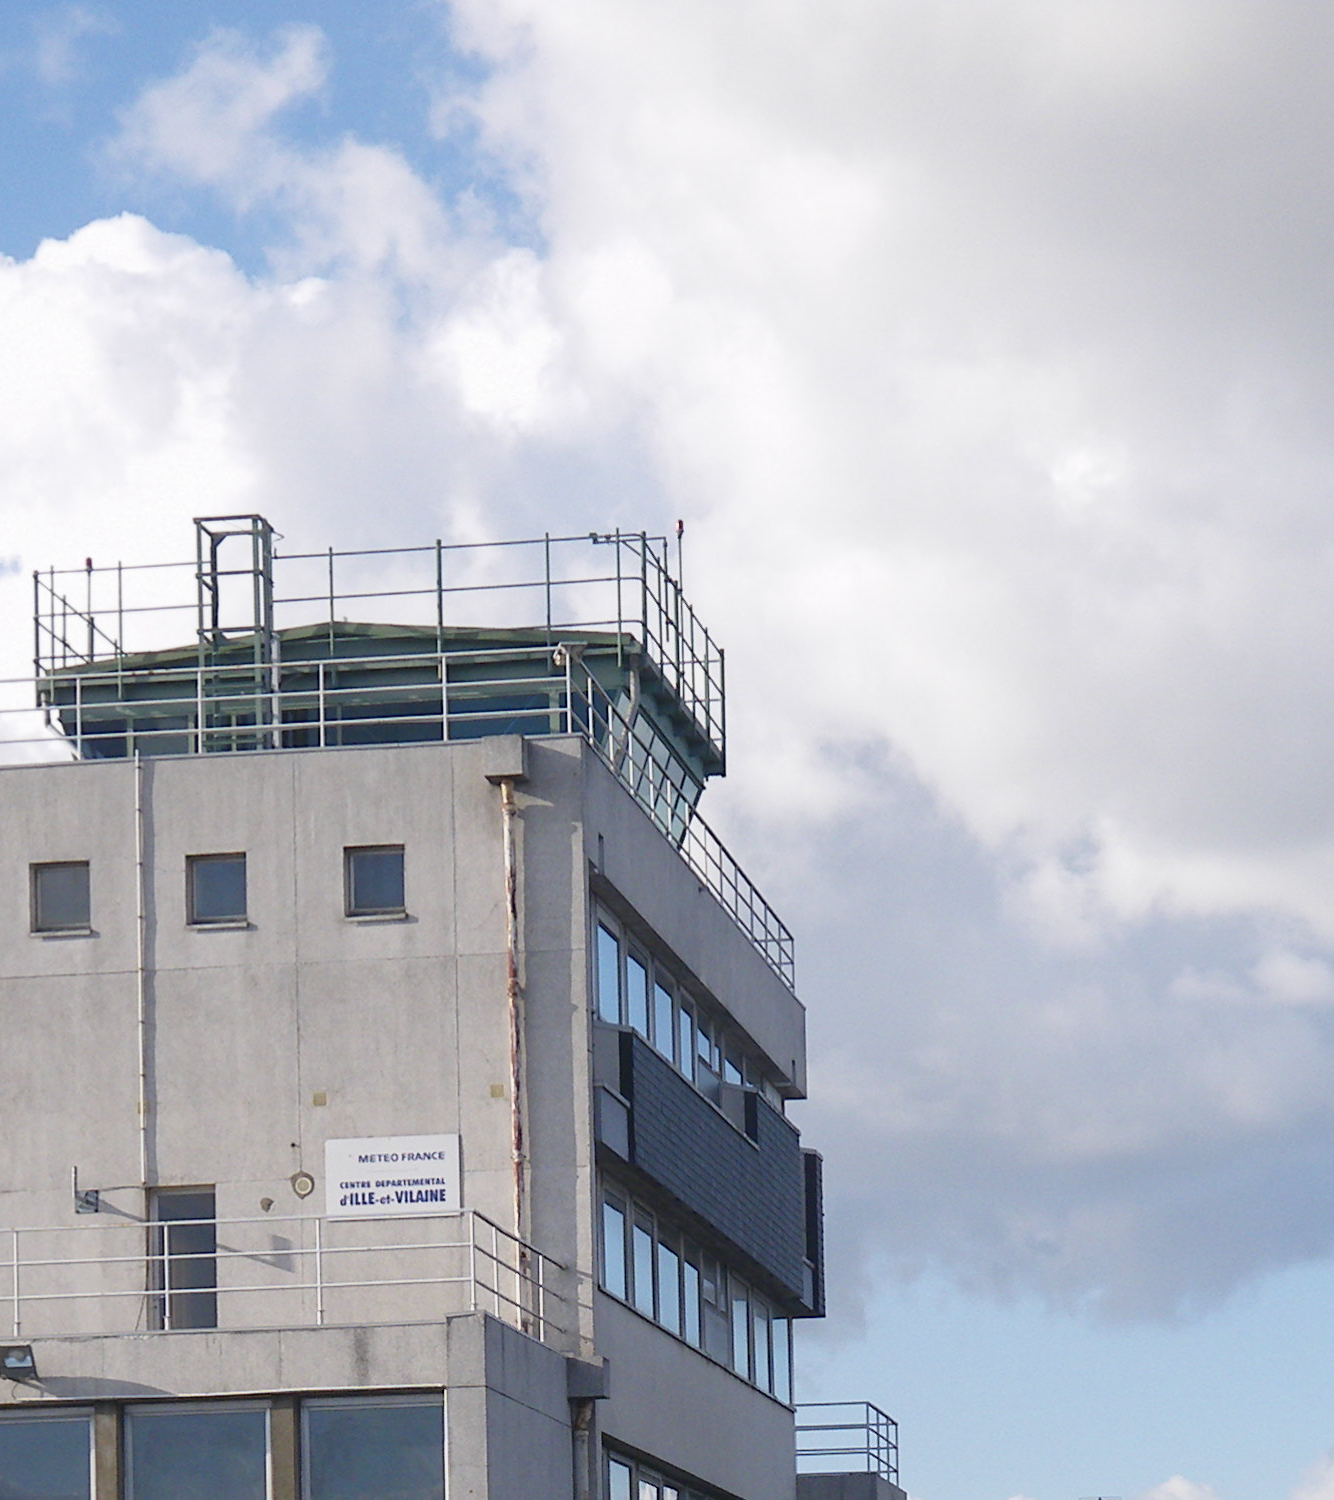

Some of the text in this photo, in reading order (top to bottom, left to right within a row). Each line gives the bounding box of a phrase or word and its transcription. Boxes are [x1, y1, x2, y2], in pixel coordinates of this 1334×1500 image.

[358, 1151, 445, 1163] METEO FRANCE
[340, 1178, 445, 1189] CENTRE DEPARTEMENTAL
